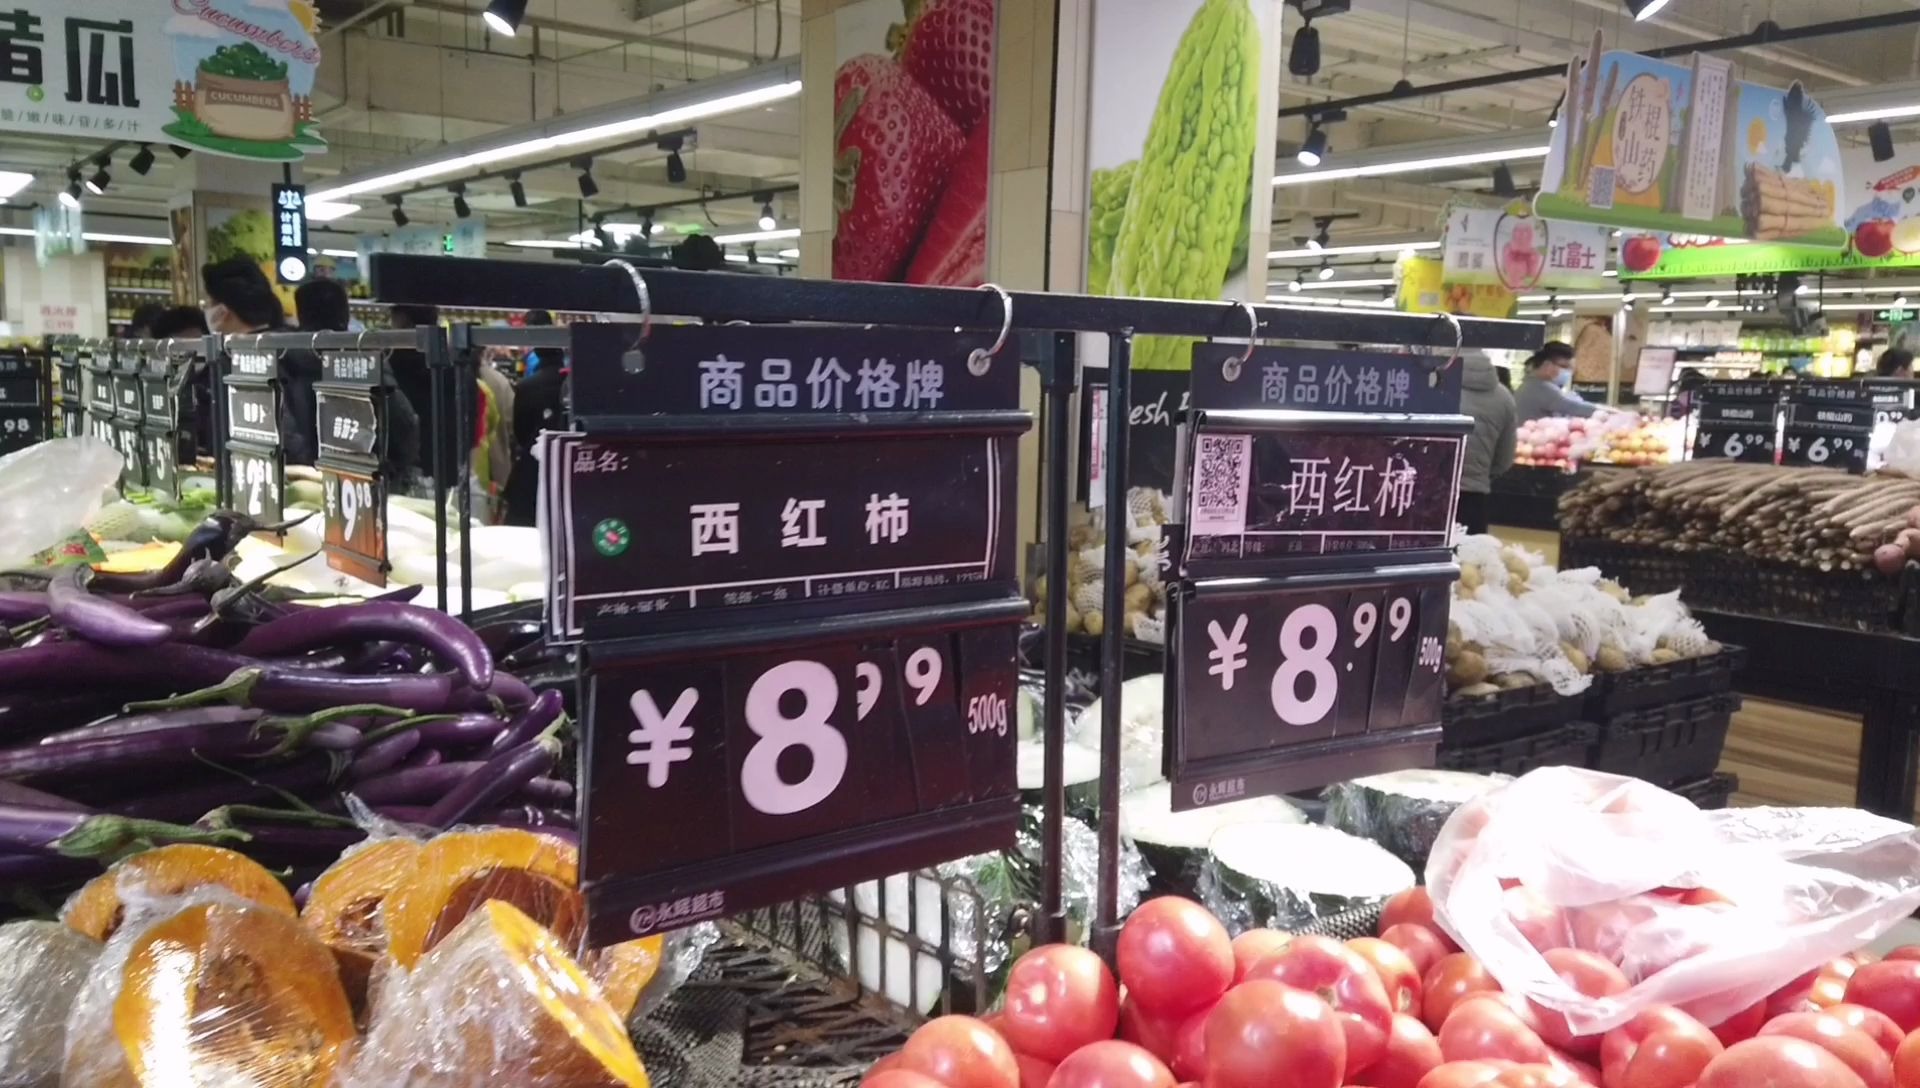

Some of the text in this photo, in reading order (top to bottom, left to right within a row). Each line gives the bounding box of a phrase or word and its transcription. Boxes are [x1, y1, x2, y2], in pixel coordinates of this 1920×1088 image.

[1551, 241, 1597, 269] 红富士
[698, 353, 945, 410] 商品价格牌
[1260, 361, 1411, 408] 商品价格牌
[1288, 455, 1419, 519] 西红柿
[689, 491, 911, 557] 西红柿
[1418, 635, 1444, 674] 500g
[967, 692, 1008, 738] 500g
